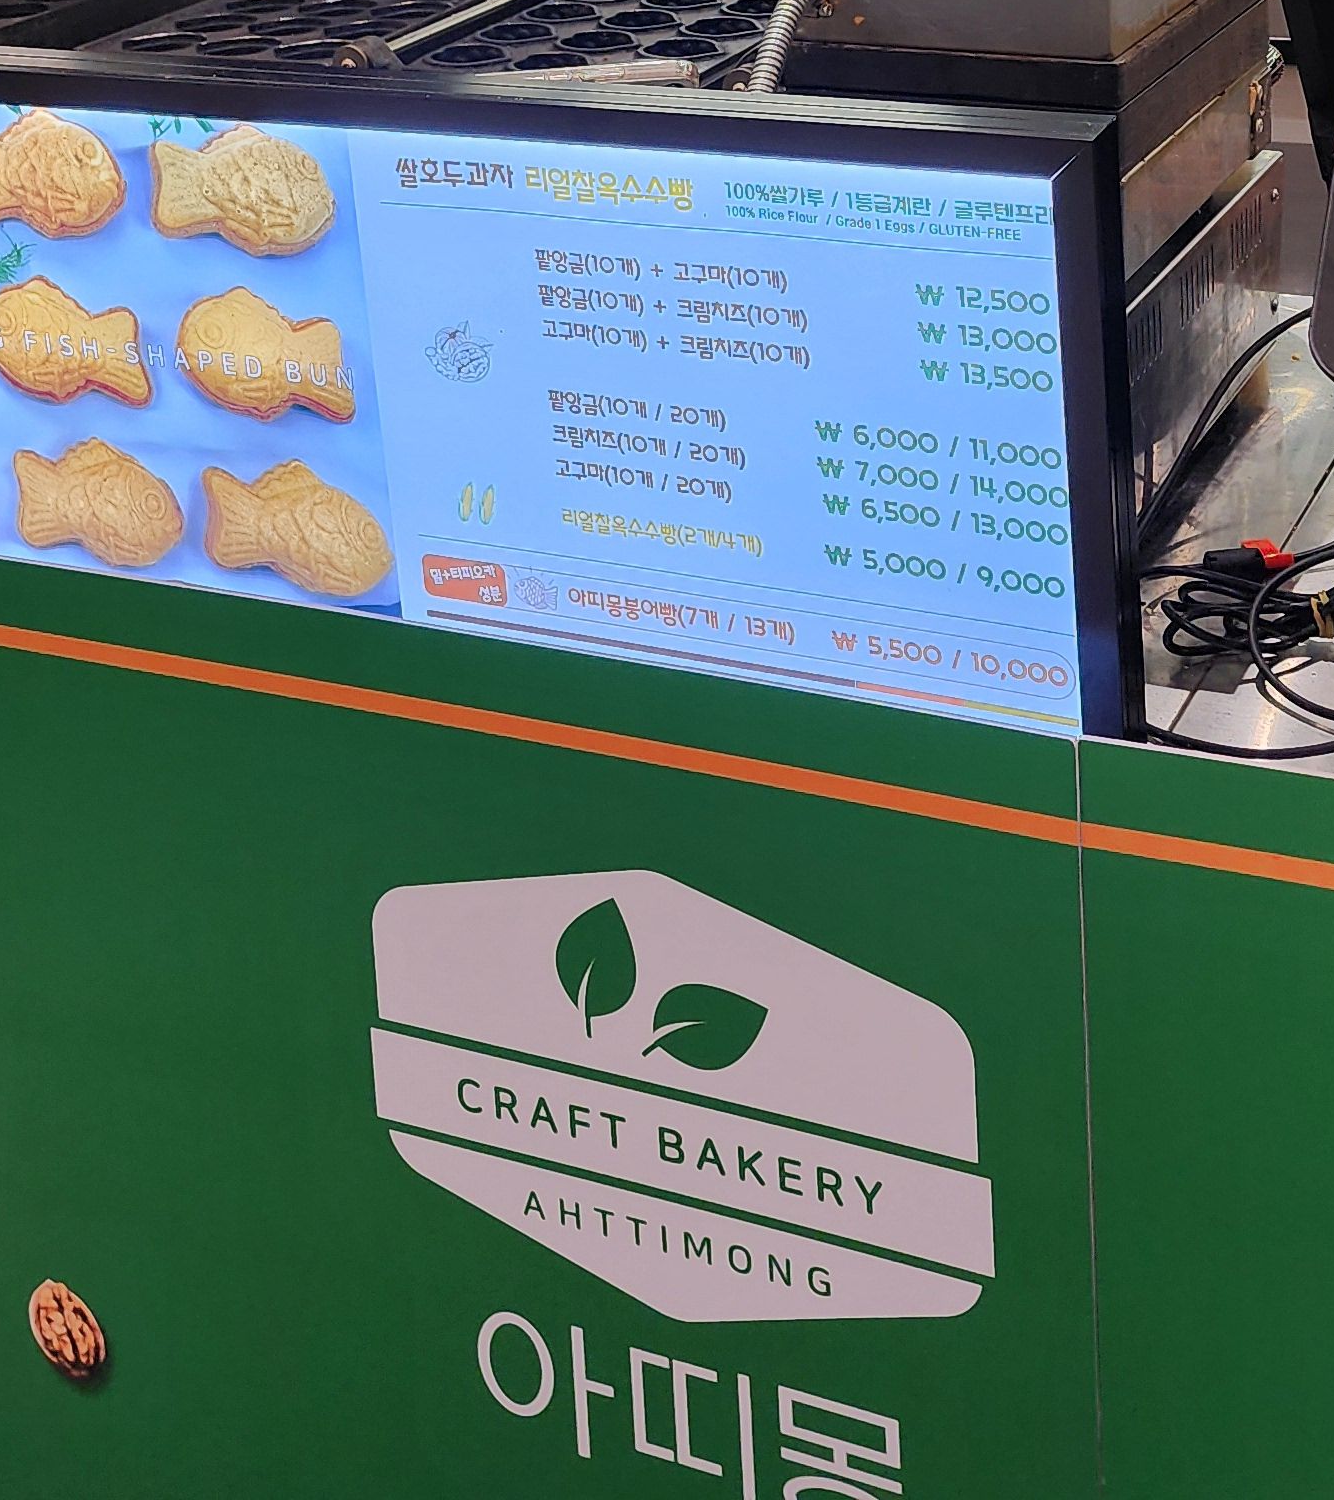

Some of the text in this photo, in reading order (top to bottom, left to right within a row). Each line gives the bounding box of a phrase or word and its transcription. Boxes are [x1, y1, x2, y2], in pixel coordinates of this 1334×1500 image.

[396, 157, 694, 212] 쌀호두과자 리얼찰옥수수빵
[724, 181, 825, 208] 100%쌀가루
[846, 192, 931, 218] 1등급계란
[725, 205, 756, 219] 100%
[759, 208, 784, 222] Rice
[788, 211, 818, 224] Flour
[835, 216, 872, 229] Grade
[885, 220, 915, 235] Eggs
[929, 224, 1022, 241] GLUTEN-FREE
[534, 248, 788, 294] 팥앙금(10개) + 고구마(10개)
[537, 284, 808, 334] 팥앙금(10개) + 크림치즈(10개)
[956, 285, 1051, 315] 12,500
[24, 330, 263, 380] FISH-SHAPED
[284, 357, 355, 392] BUN
[542, 319, 811, 370] 고구마(10개) + 크림치즈(10개)
[958, 324, 1058, 355] 13,000
[960, 362, 1054, 392] 13,500
[548, 390, 648, 419] 팥앙금(10개
[670, 405, 726, 432] 20개)
[553, 425, 667, 456] 크림치즈(10개
[690, 442, 746, 470] 20개)
[853, 424, 939, 454] 6,000
[949, 436, 959, 458] /
[969, 438, 1062, 470] 11,000
[556, 459, 654, 488] 고구마(10개
[676, 476, 732, 504] 20개)
[855, 461, 939, 491] 7,000
[950, 473, 959, 495] /
[970, 475, 1068, 508] 14,000
[861, 498, 940, 528] 6,500
[950, 510, 961, 532] /
[971, 512, 1068, 546] 13,000
[862, 549, 947, 580] 5,000
[957, 563, 967, 584] /
[977, 565, 1065, 598] 9,000
[568, 588, 719, 629] 아띠몽붕어빵(7개
[744, 616, 796, 645] 13개)
[868, 636, 942, 665] 5,500
[952, 650, 961, 669] /
[971, 652, 1068, 687] 10,000
[456, 1077, 884, 1216] CRAFT BAKERY
[523, 1190, 834, 1298] AHTTIMONG
[477, 1311, 904, 1500] 아띠몽
